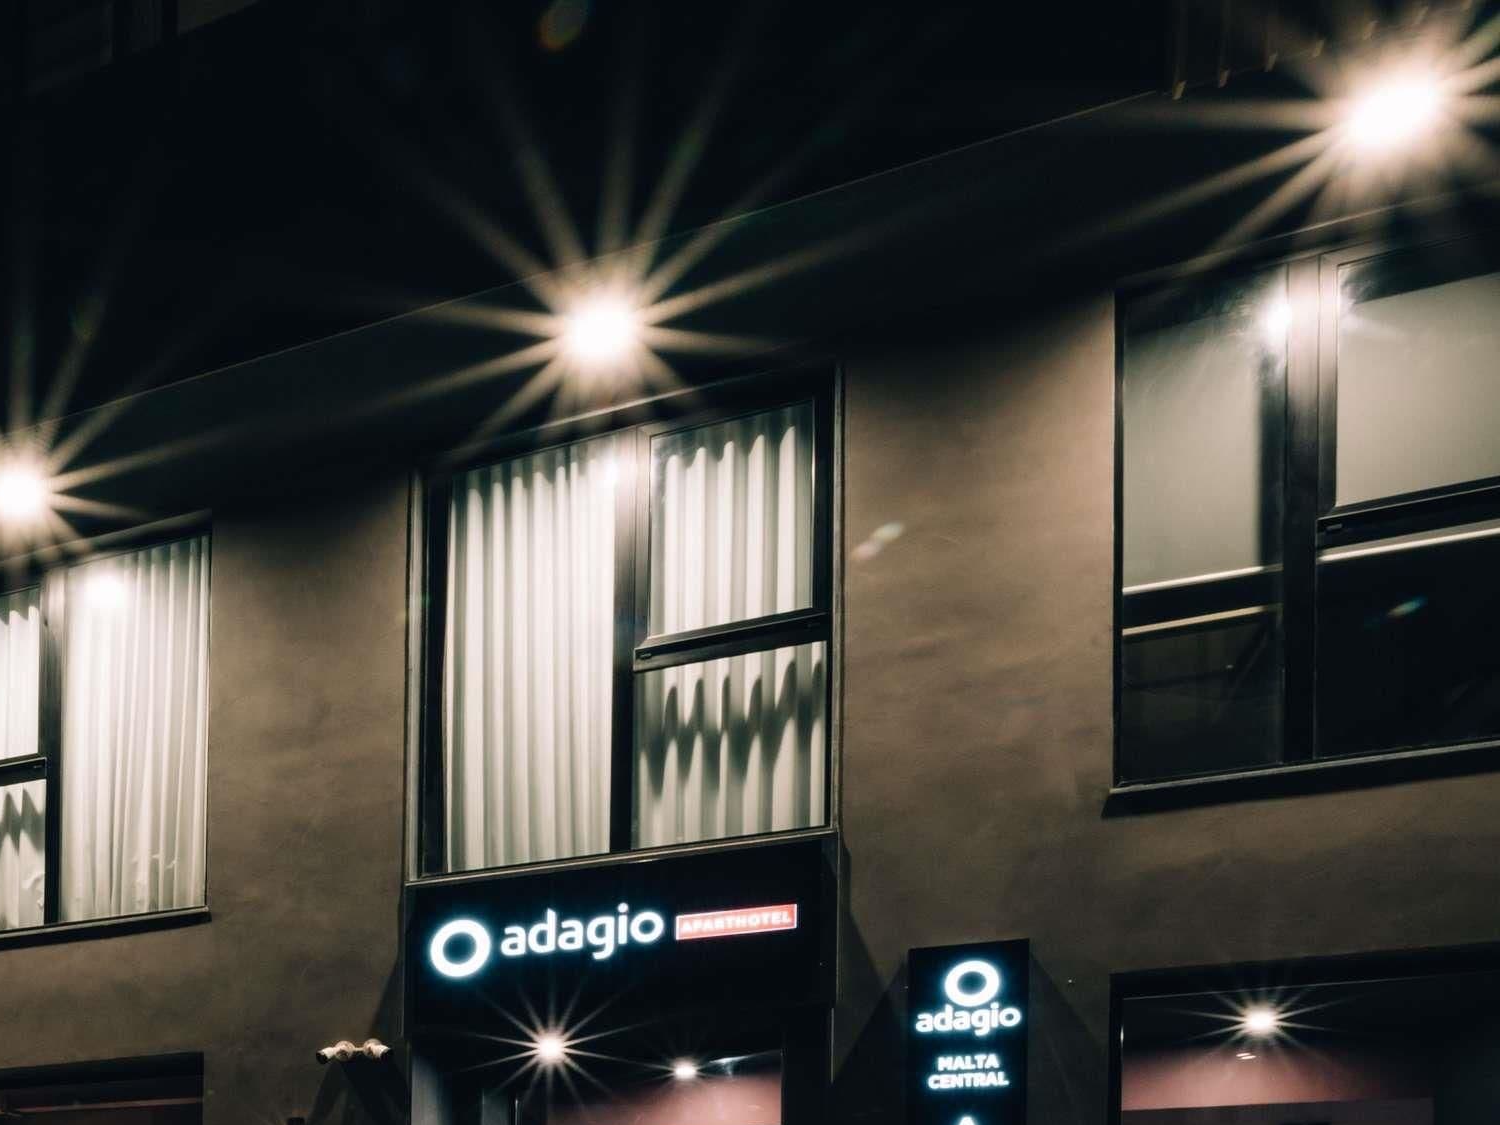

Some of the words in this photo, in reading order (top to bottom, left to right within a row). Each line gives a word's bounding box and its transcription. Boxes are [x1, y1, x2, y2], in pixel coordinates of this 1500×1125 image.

[501, 902, 665, 960] adagio
[682, 911, 790, 932] APARTHOTEL
[916, 1002, 1021, 1036] adagio
[937, 1054, 999, 1071] MALTA
[928, 1072, 1010, 1089] CENTRAL
